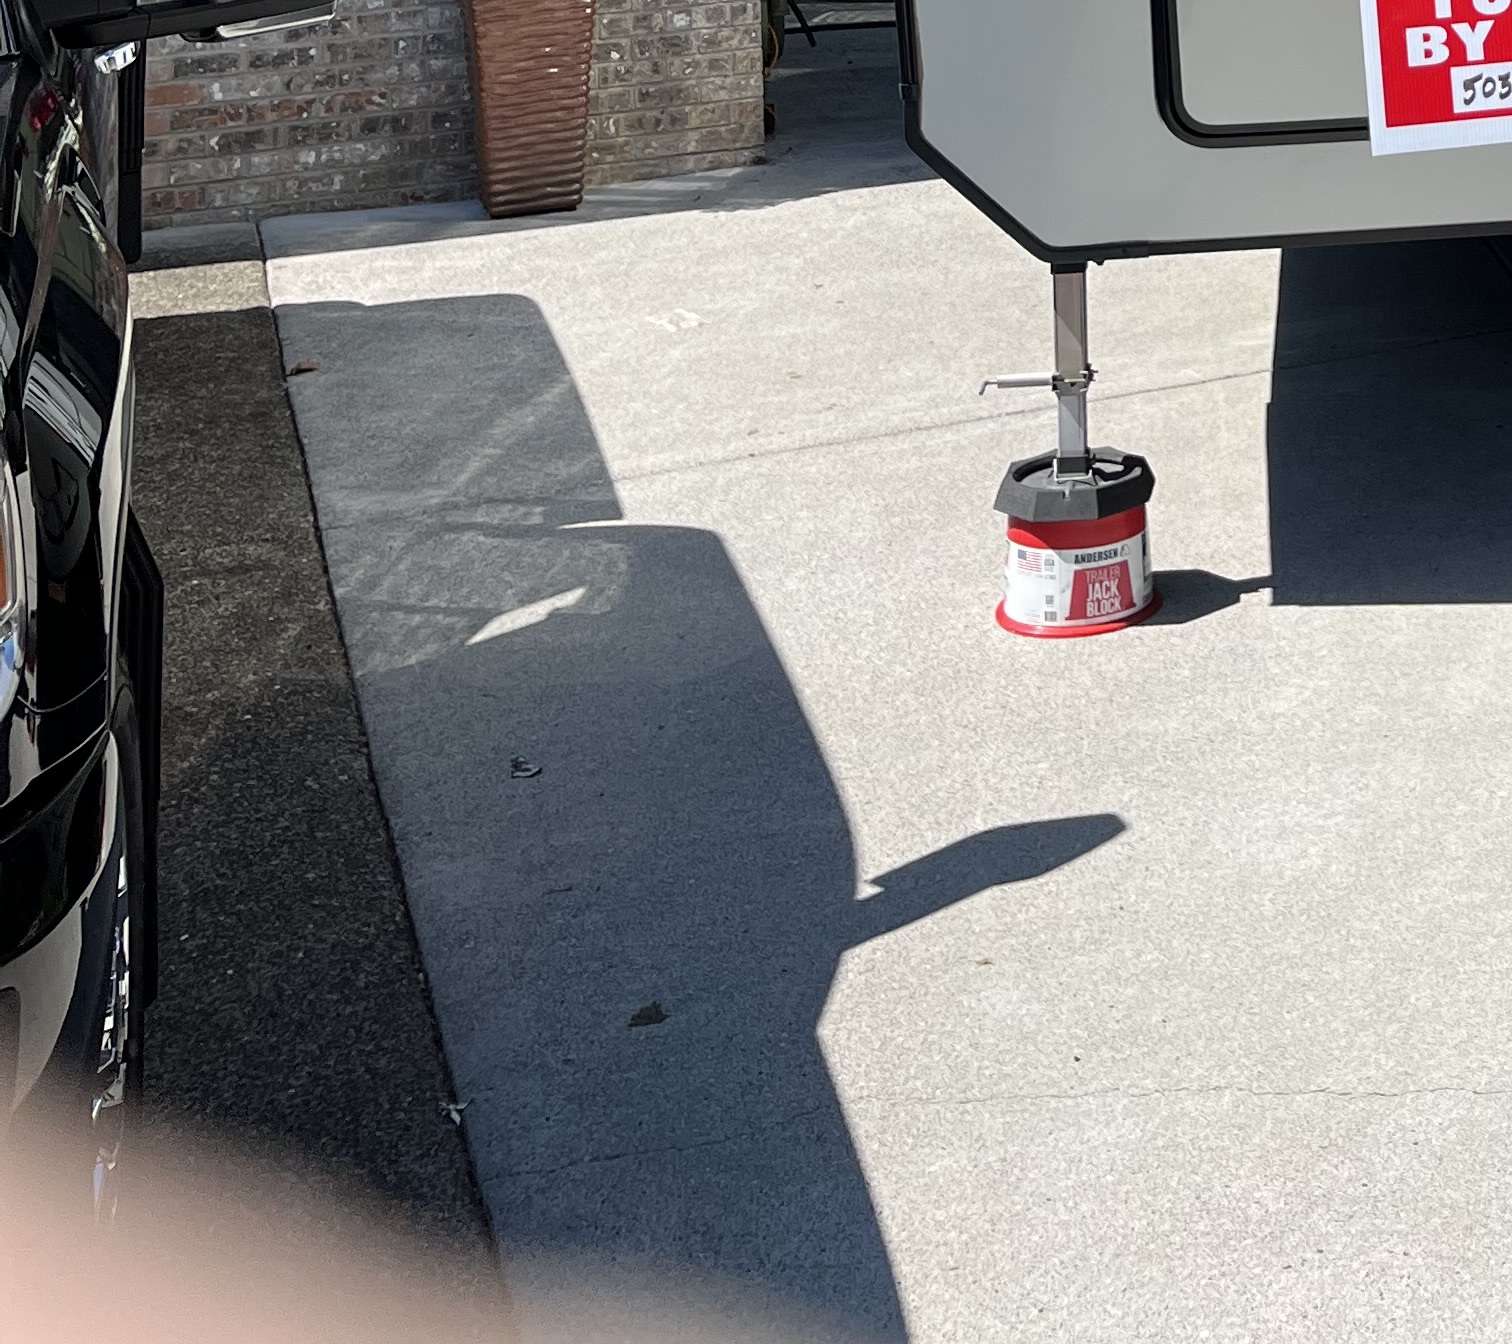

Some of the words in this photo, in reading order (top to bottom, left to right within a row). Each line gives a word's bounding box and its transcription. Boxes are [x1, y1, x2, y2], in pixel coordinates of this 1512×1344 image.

[1405, 19, 1495, 67] BY
[1074, 548, 1118, 564] ANDERSEN
[1085, 565, 1120, 583] TRAILER
[1087, 578, 1119, 601] JACK
[1086, 596, 1122, 617] BLOCK
